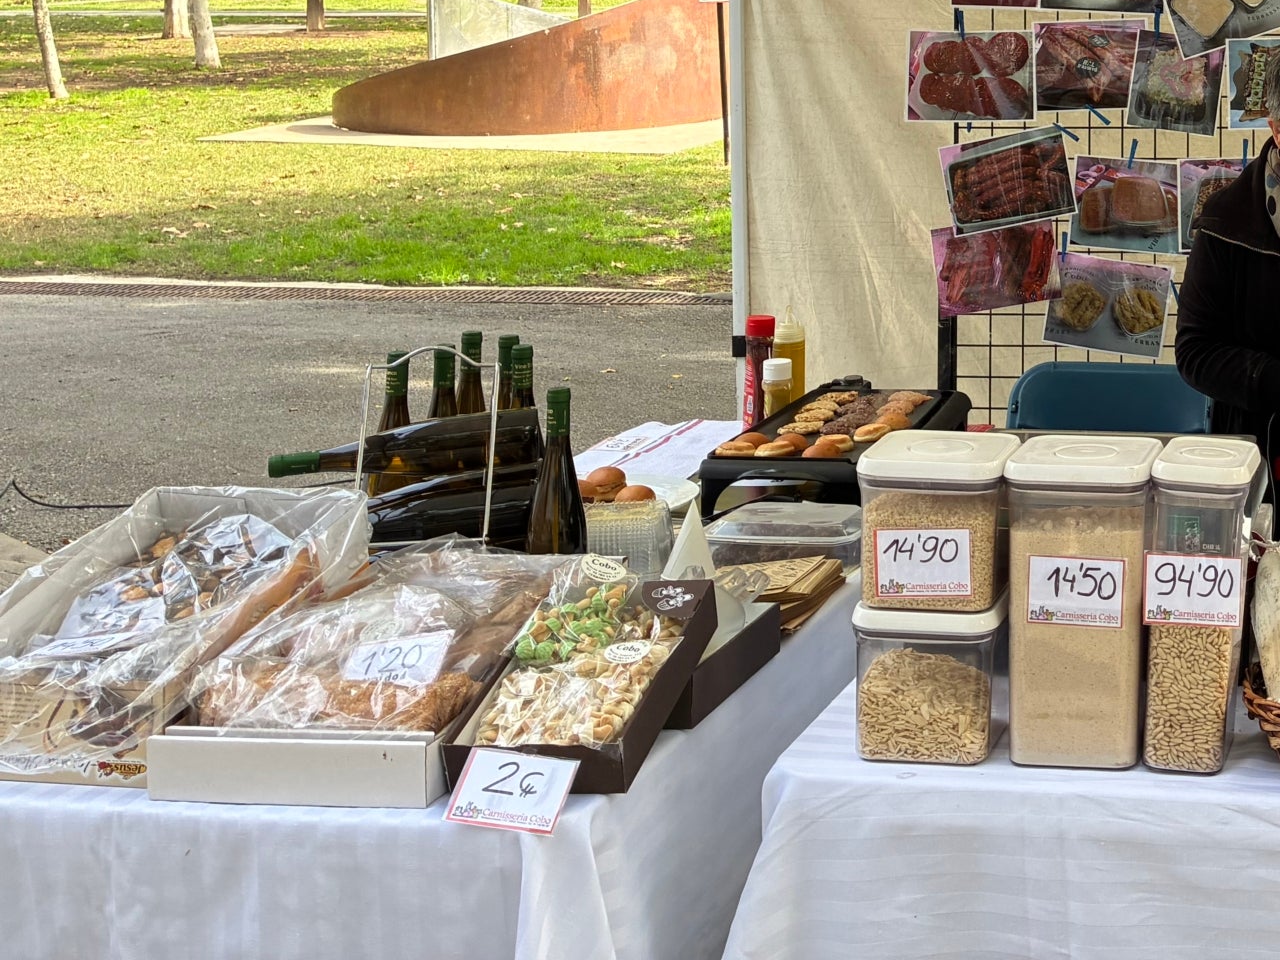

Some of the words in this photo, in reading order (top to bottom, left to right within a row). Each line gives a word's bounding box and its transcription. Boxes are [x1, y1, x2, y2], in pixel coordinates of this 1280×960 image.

[882, 533, 959, 563] 14'90
[591, 558, 618, 572] Cobo
[905, 581, 947, 590] Carnisseria
[948, 581, 969, 590] Cobo
[1046, 562, 1117, 601] 14'50
[1154, 562, 1234, 599] 94'90
[1055, 610, 1098, 621] Carnisseria
[1098, 612, 1119, 622] Cobo
[1173, 609, 1216, 619] Carnisseria
[1216, 610, 1237, 621] Cobo
[616, 643, 641, 653] Cobo
[361, 644, 423, 676] 1'20
[482, 808, 528, 822] Carnisseria
[529, 813, 552, 825] Cobo
